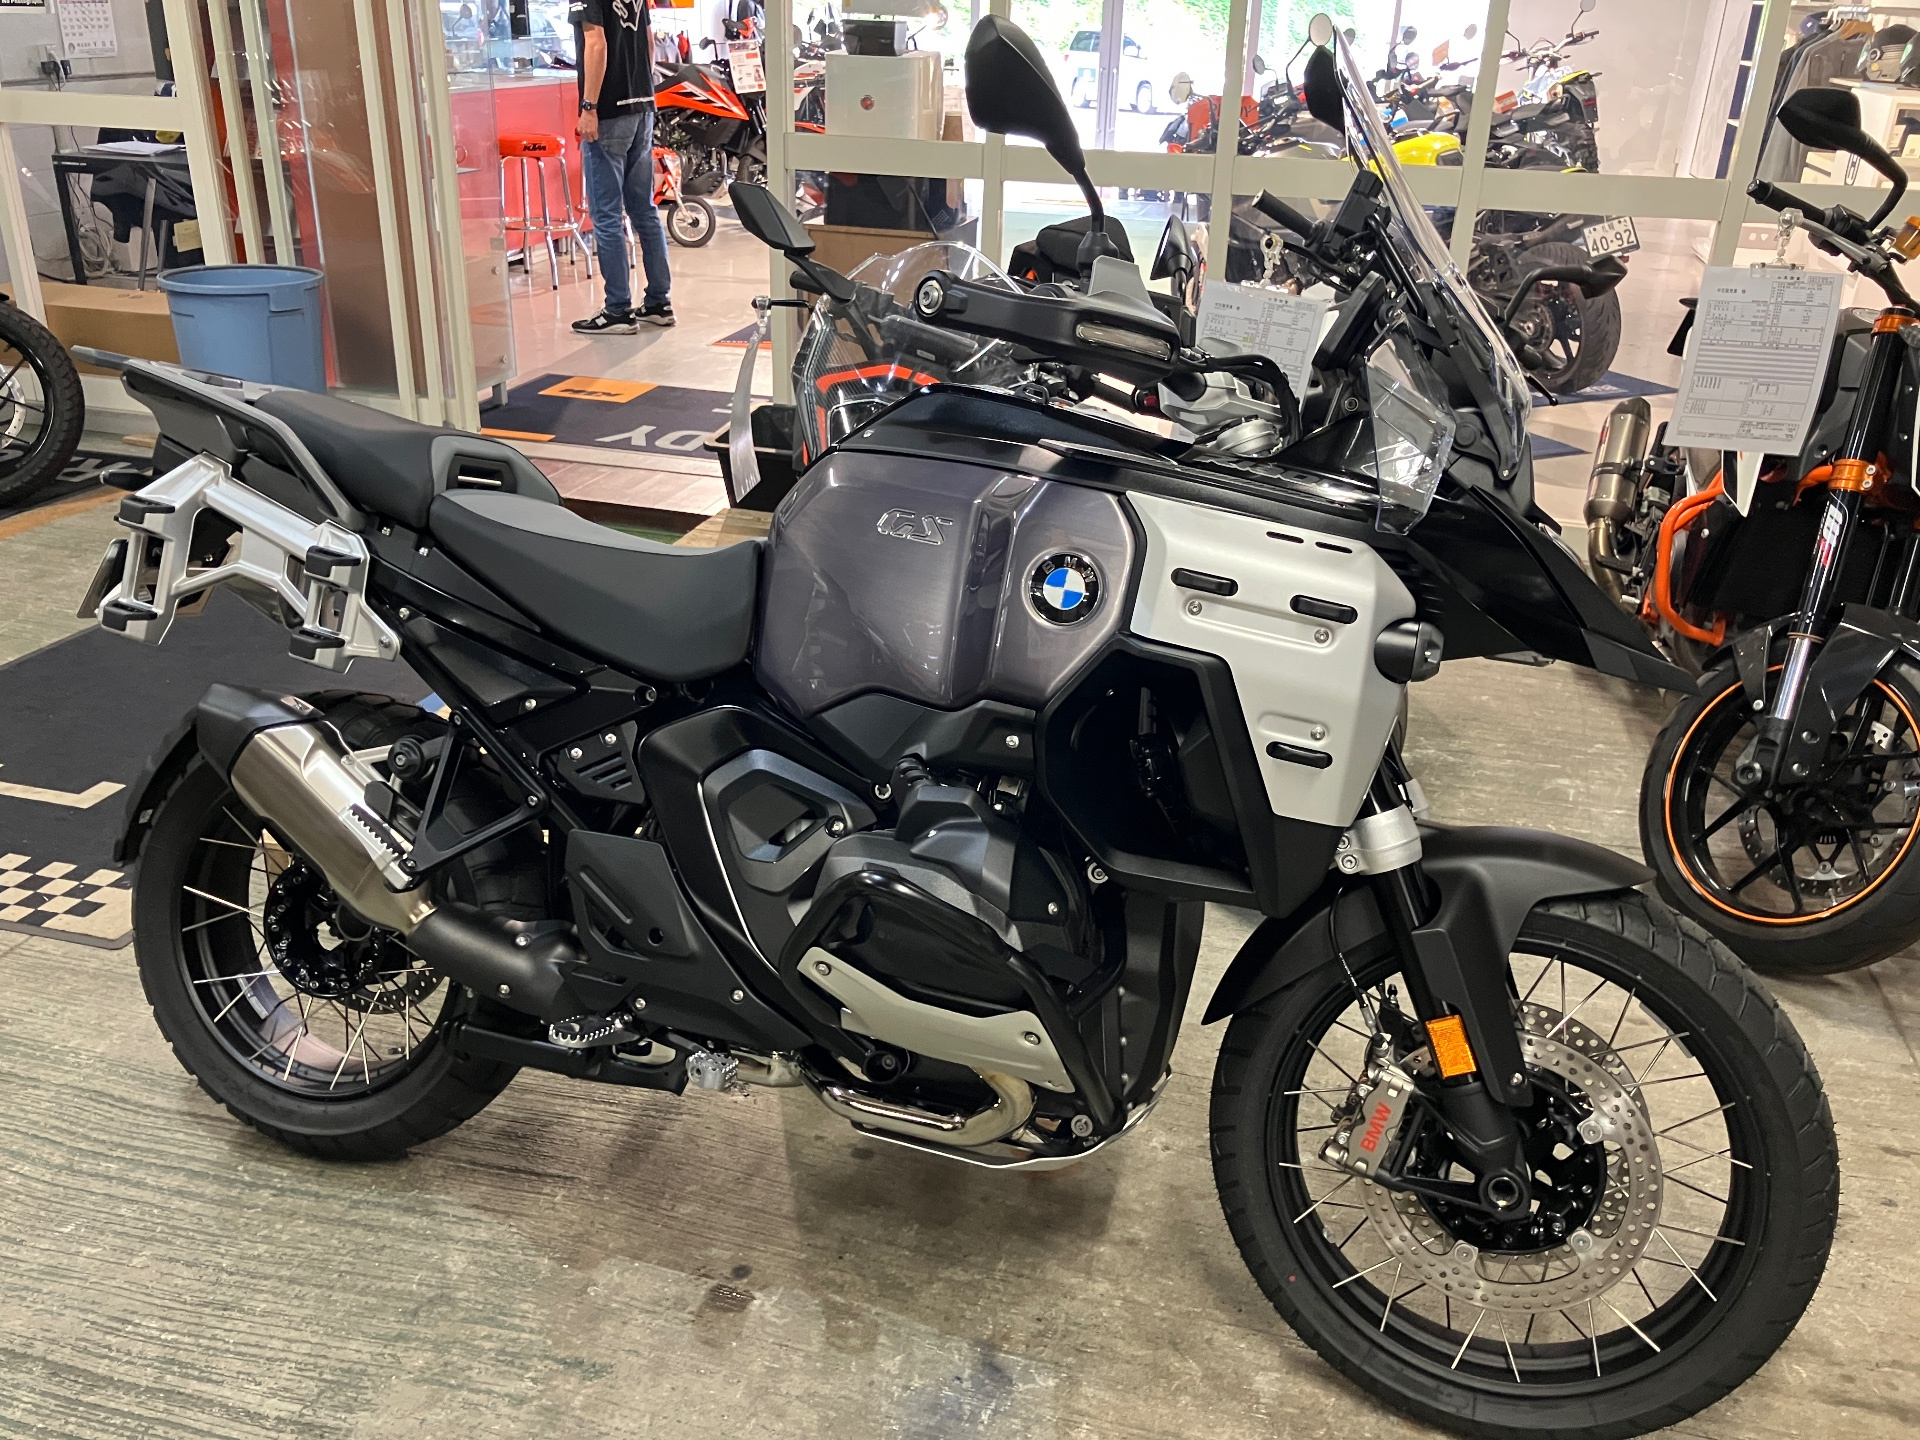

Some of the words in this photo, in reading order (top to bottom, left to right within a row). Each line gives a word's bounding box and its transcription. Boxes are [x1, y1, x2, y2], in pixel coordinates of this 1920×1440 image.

[523, 143, 546, 152] KTM
[1592, 229, 1635, 254] 40-92
[876, 508, 954, 545] GS
[1041, 555, 1096, 583] BMW
[1360, 1101, 1392, 1153] BMW
